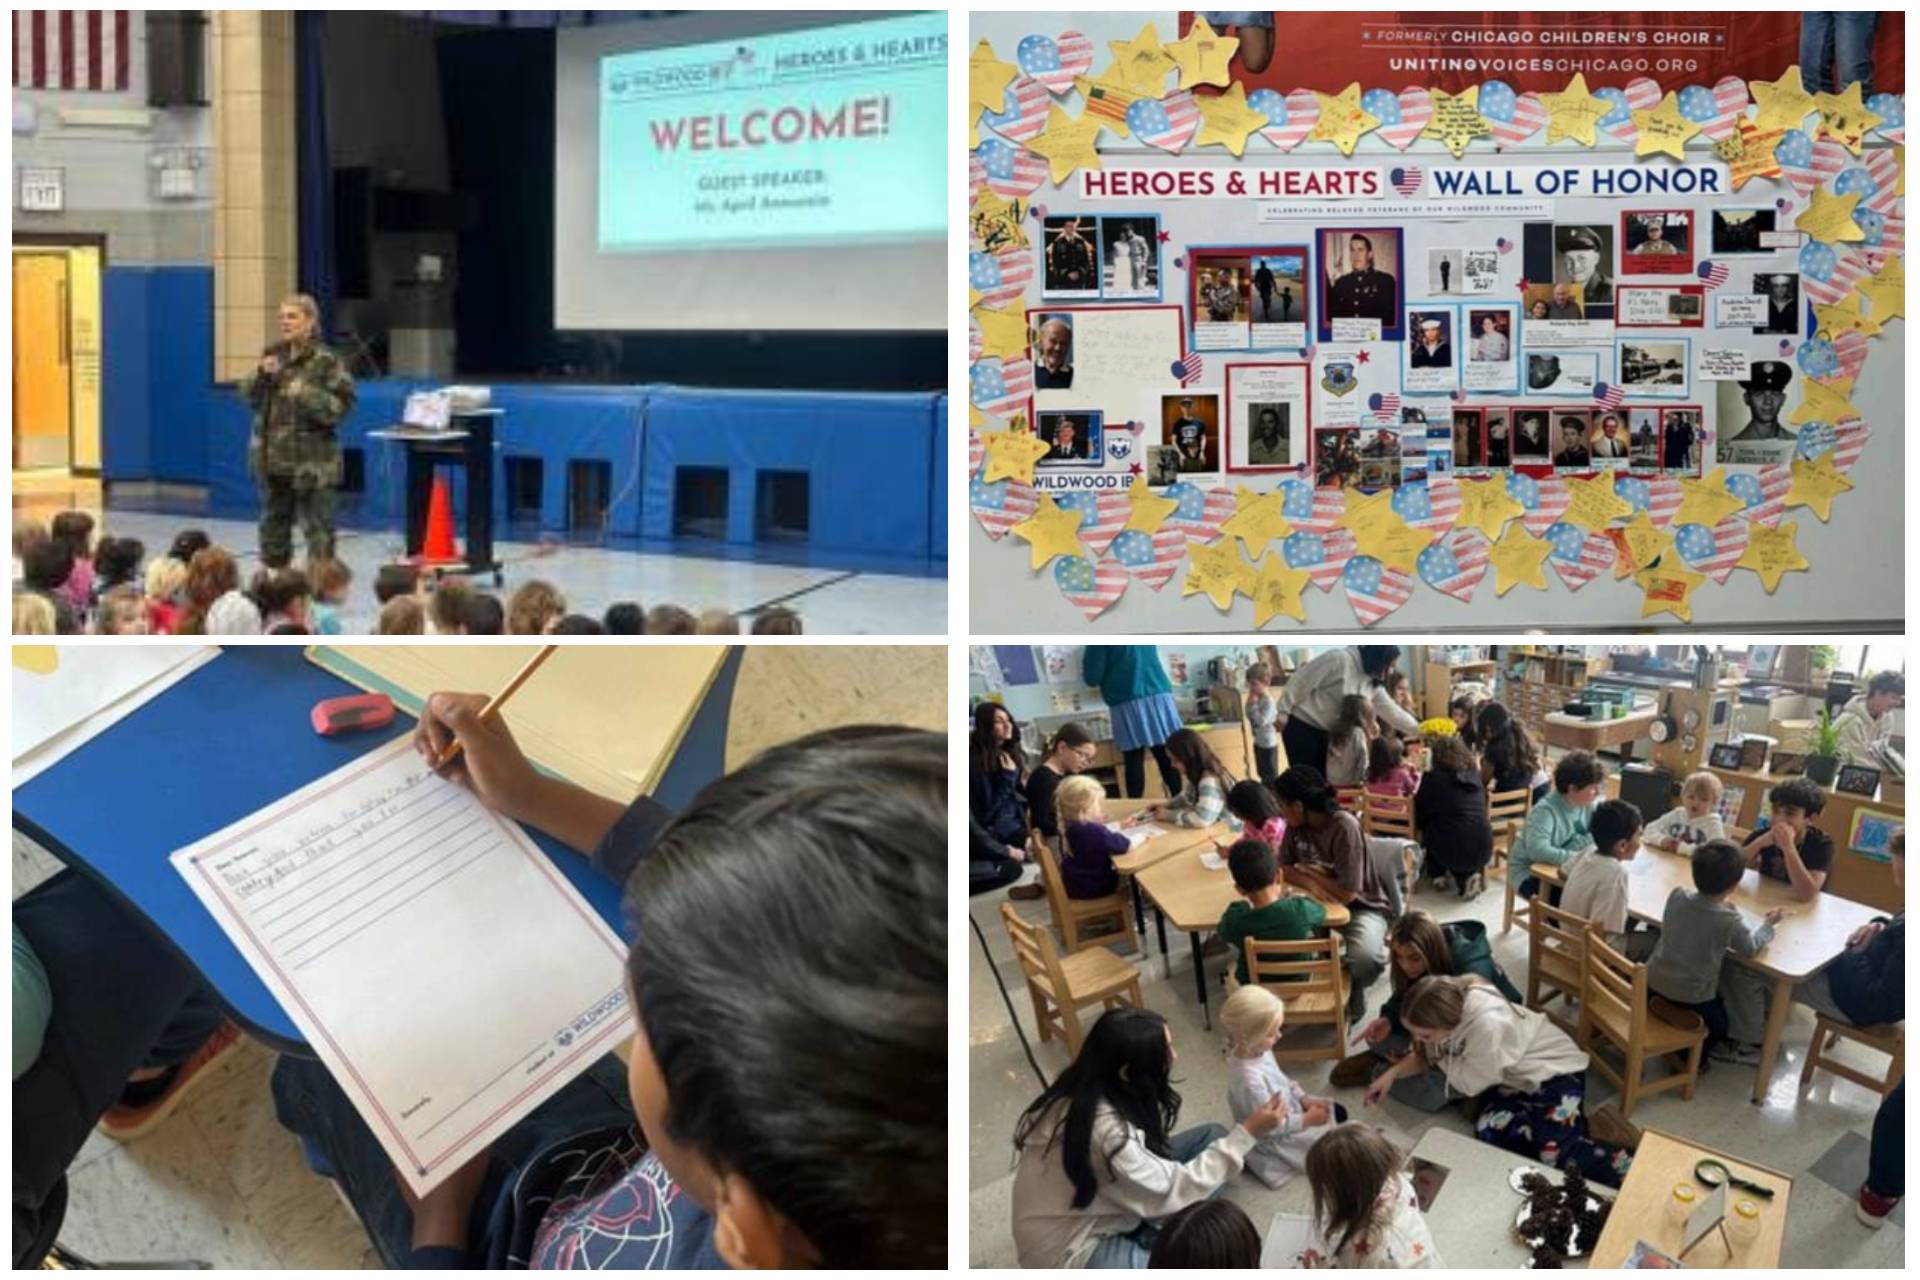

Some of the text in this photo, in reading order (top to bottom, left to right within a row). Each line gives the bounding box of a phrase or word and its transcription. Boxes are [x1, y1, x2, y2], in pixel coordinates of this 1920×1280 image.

[1377, 30, 1710, 44] FORMERLY CHICAGO CHILDREN'S CHOIR
[774, 47, 849, 71] HEROES
[1389, 58, 1699, 72] UNITINGVOICESCHICAGO.ORG
[650, 97, 890, 152] WELCOME!
[698, 173, 747, 191] GUEST
[1085, 171, 1378, 196] HEROES & HEARTS
[1433, 167, 1720, 196] WALL OF HONOR
[1033, 475, 1118, 488] WILDWOOD
[573, 992, 624, 1033] WILDWOOD
